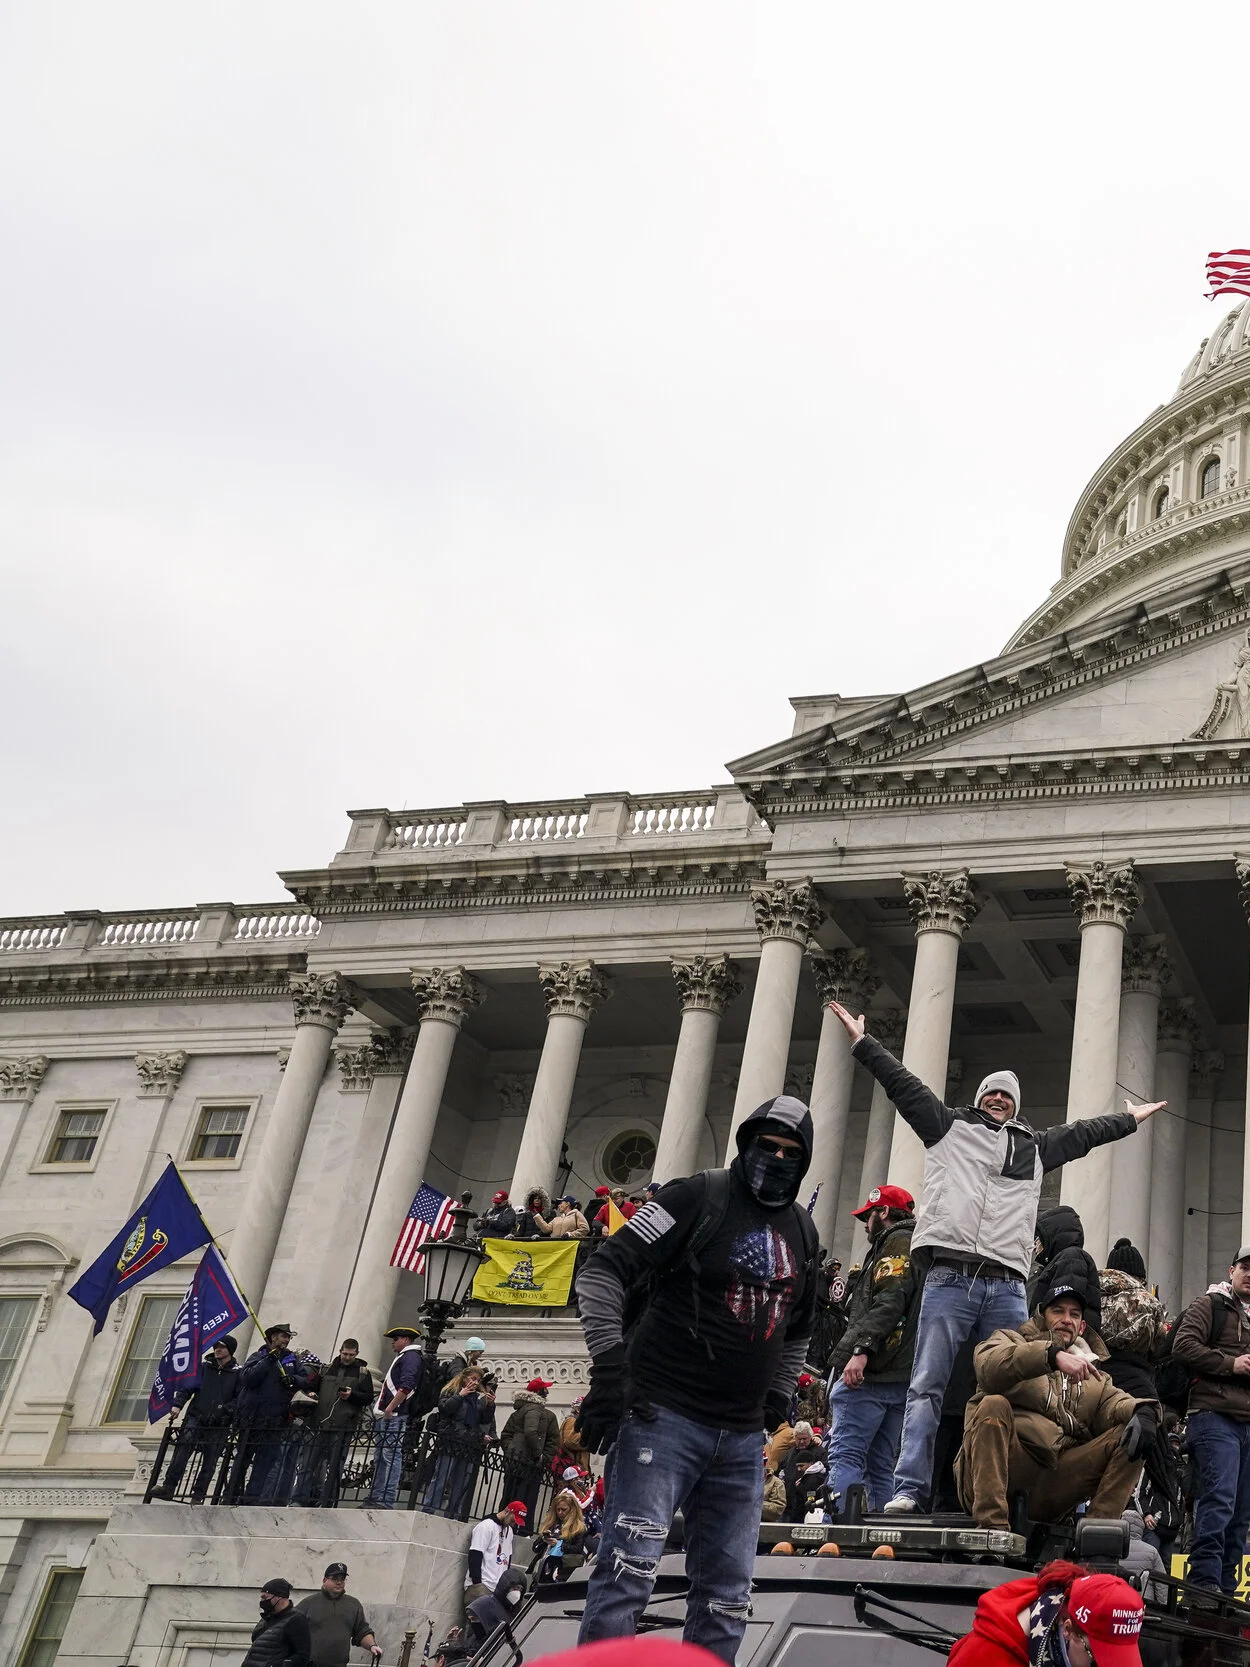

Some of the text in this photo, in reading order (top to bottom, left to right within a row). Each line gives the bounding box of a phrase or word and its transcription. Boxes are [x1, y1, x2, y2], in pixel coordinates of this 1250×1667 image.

[508, 1291, 528, 1299] TREAD
[1075, 1606, 1091, 1624] 45
[1112, 1622, 1143, 1635] TRUM
